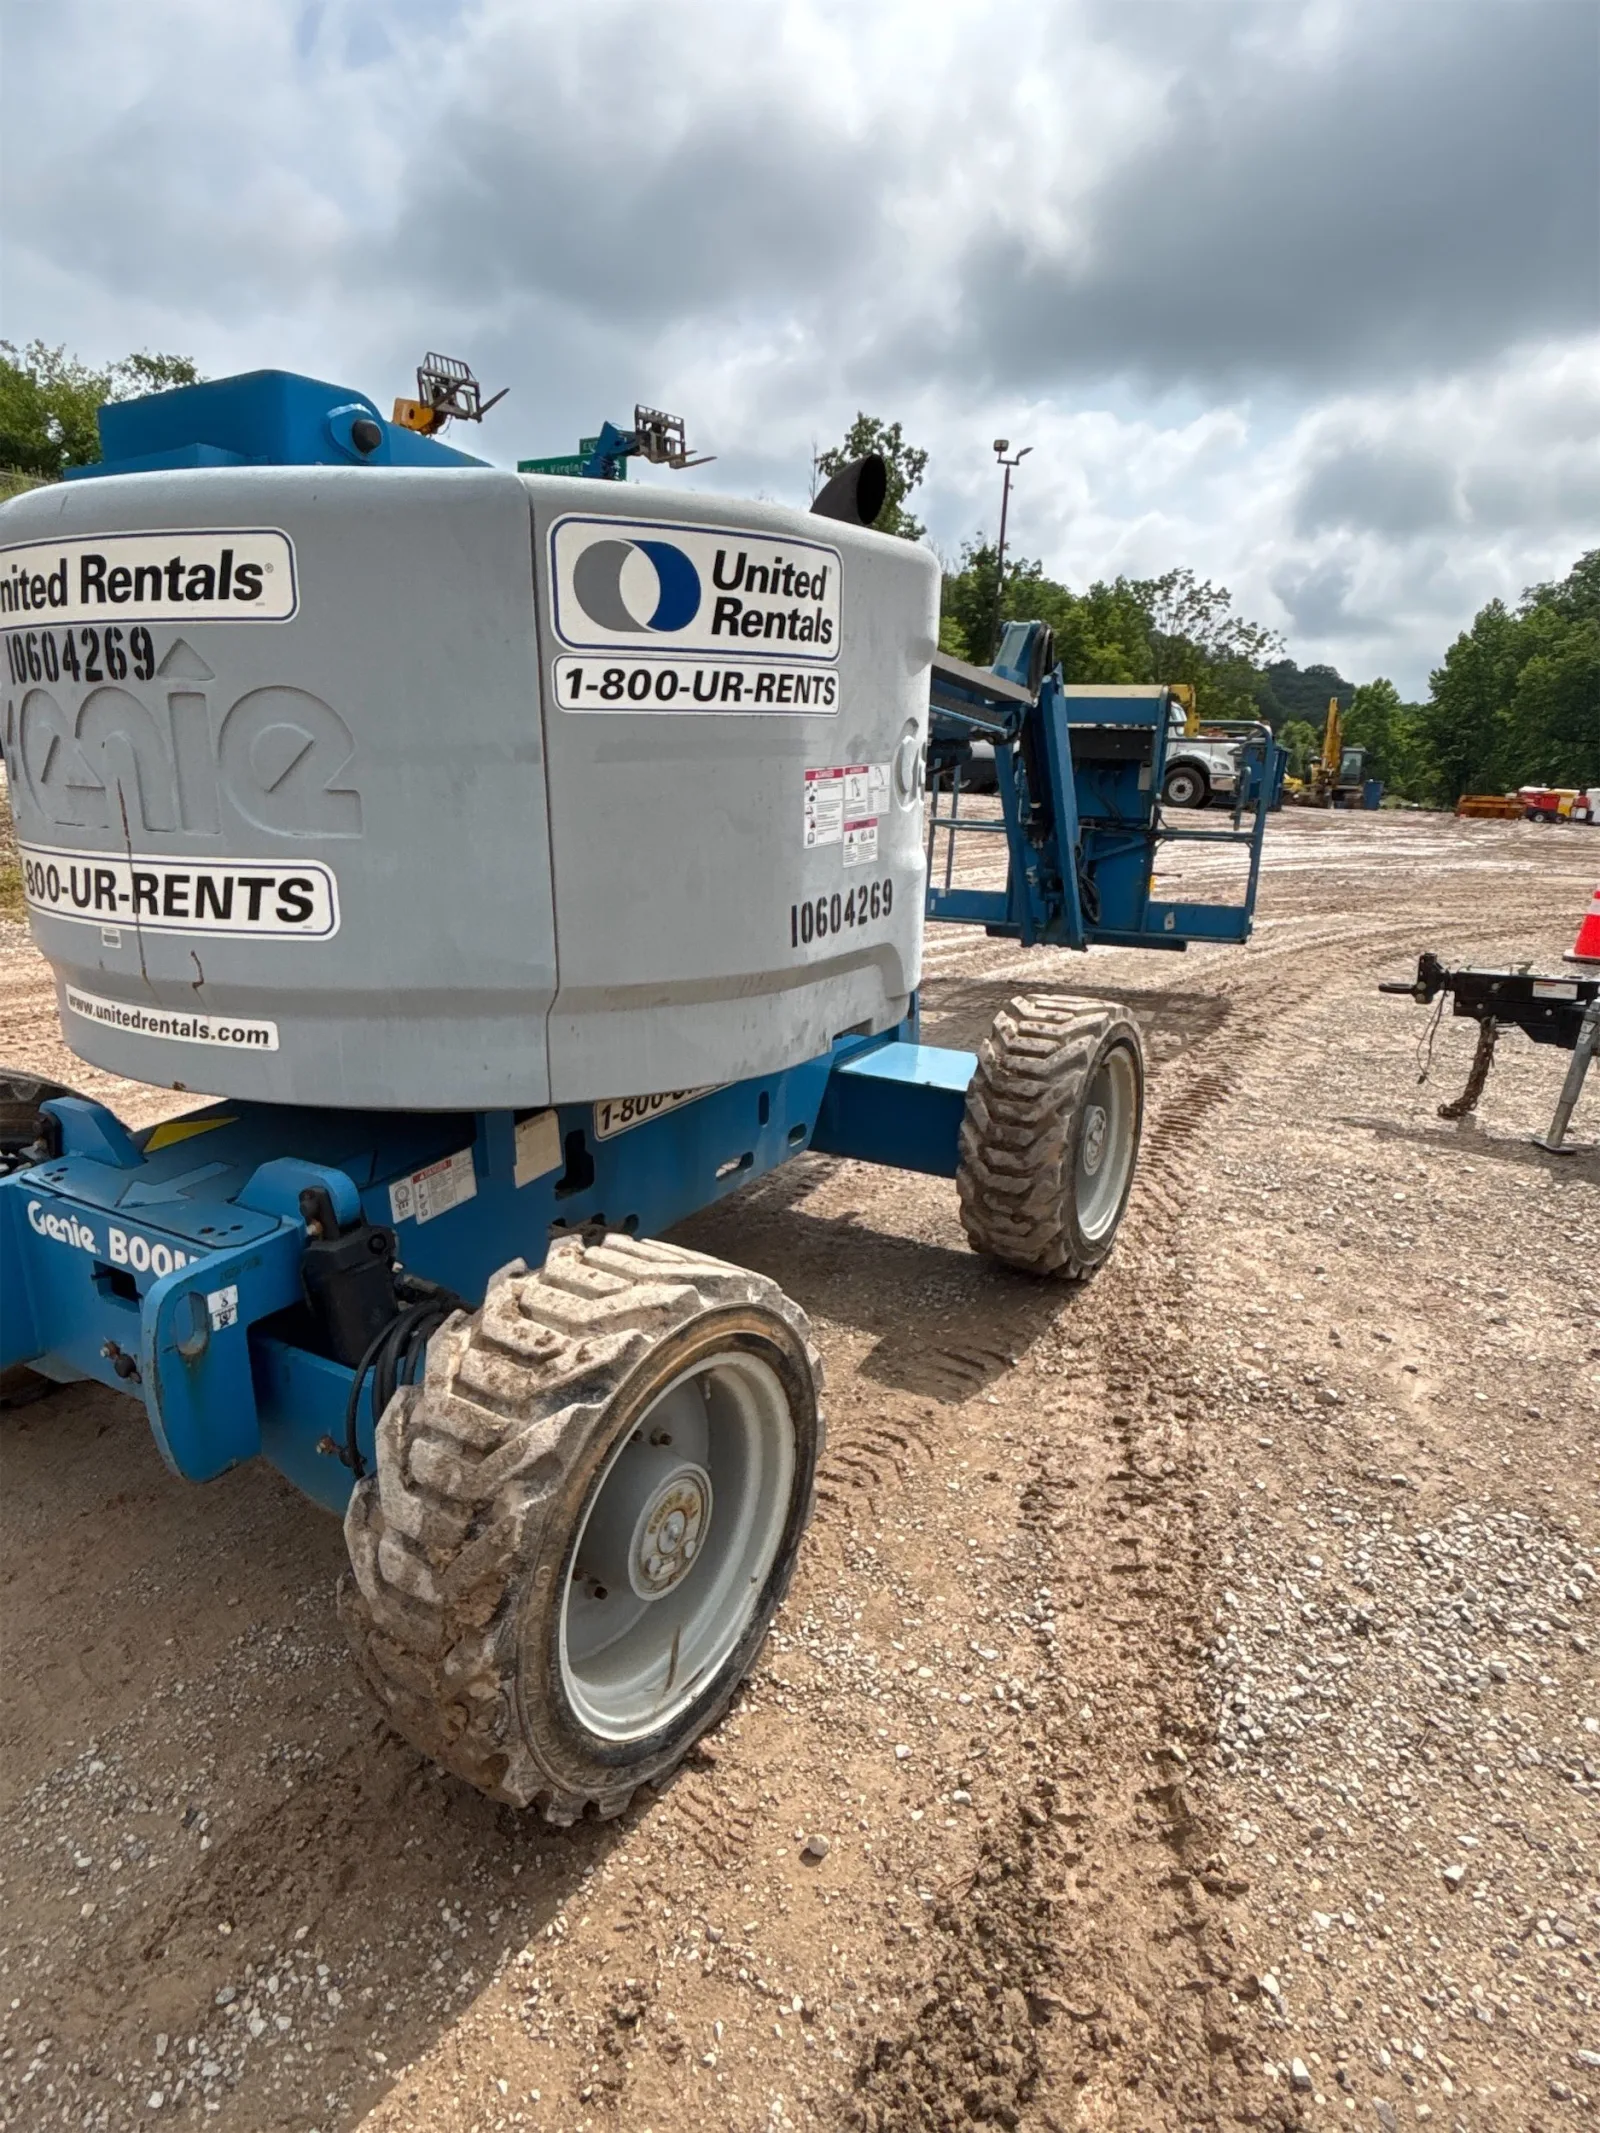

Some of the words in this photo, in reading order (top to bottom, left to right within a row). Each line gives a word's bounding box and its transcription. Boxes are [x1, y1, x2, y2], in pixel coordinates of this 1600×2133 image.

[0, 558, 68, 613] nited
[80, 549, 264, 605] Rentals
[712, 549, 828, 602] United
[711, 596, 833, 645] Rentals
[6, 626, 156, 686] 10604269
[565, 668, 837, 706] 1-800-UR-RENTS
[25, 859, 315, 924] 800-UR-RENTS
[791, 877, 894, 949] 10604269
[68, 994, 270, 1046] www.unitedrentals.com
[27, 1200, 97, 1255] Genie
